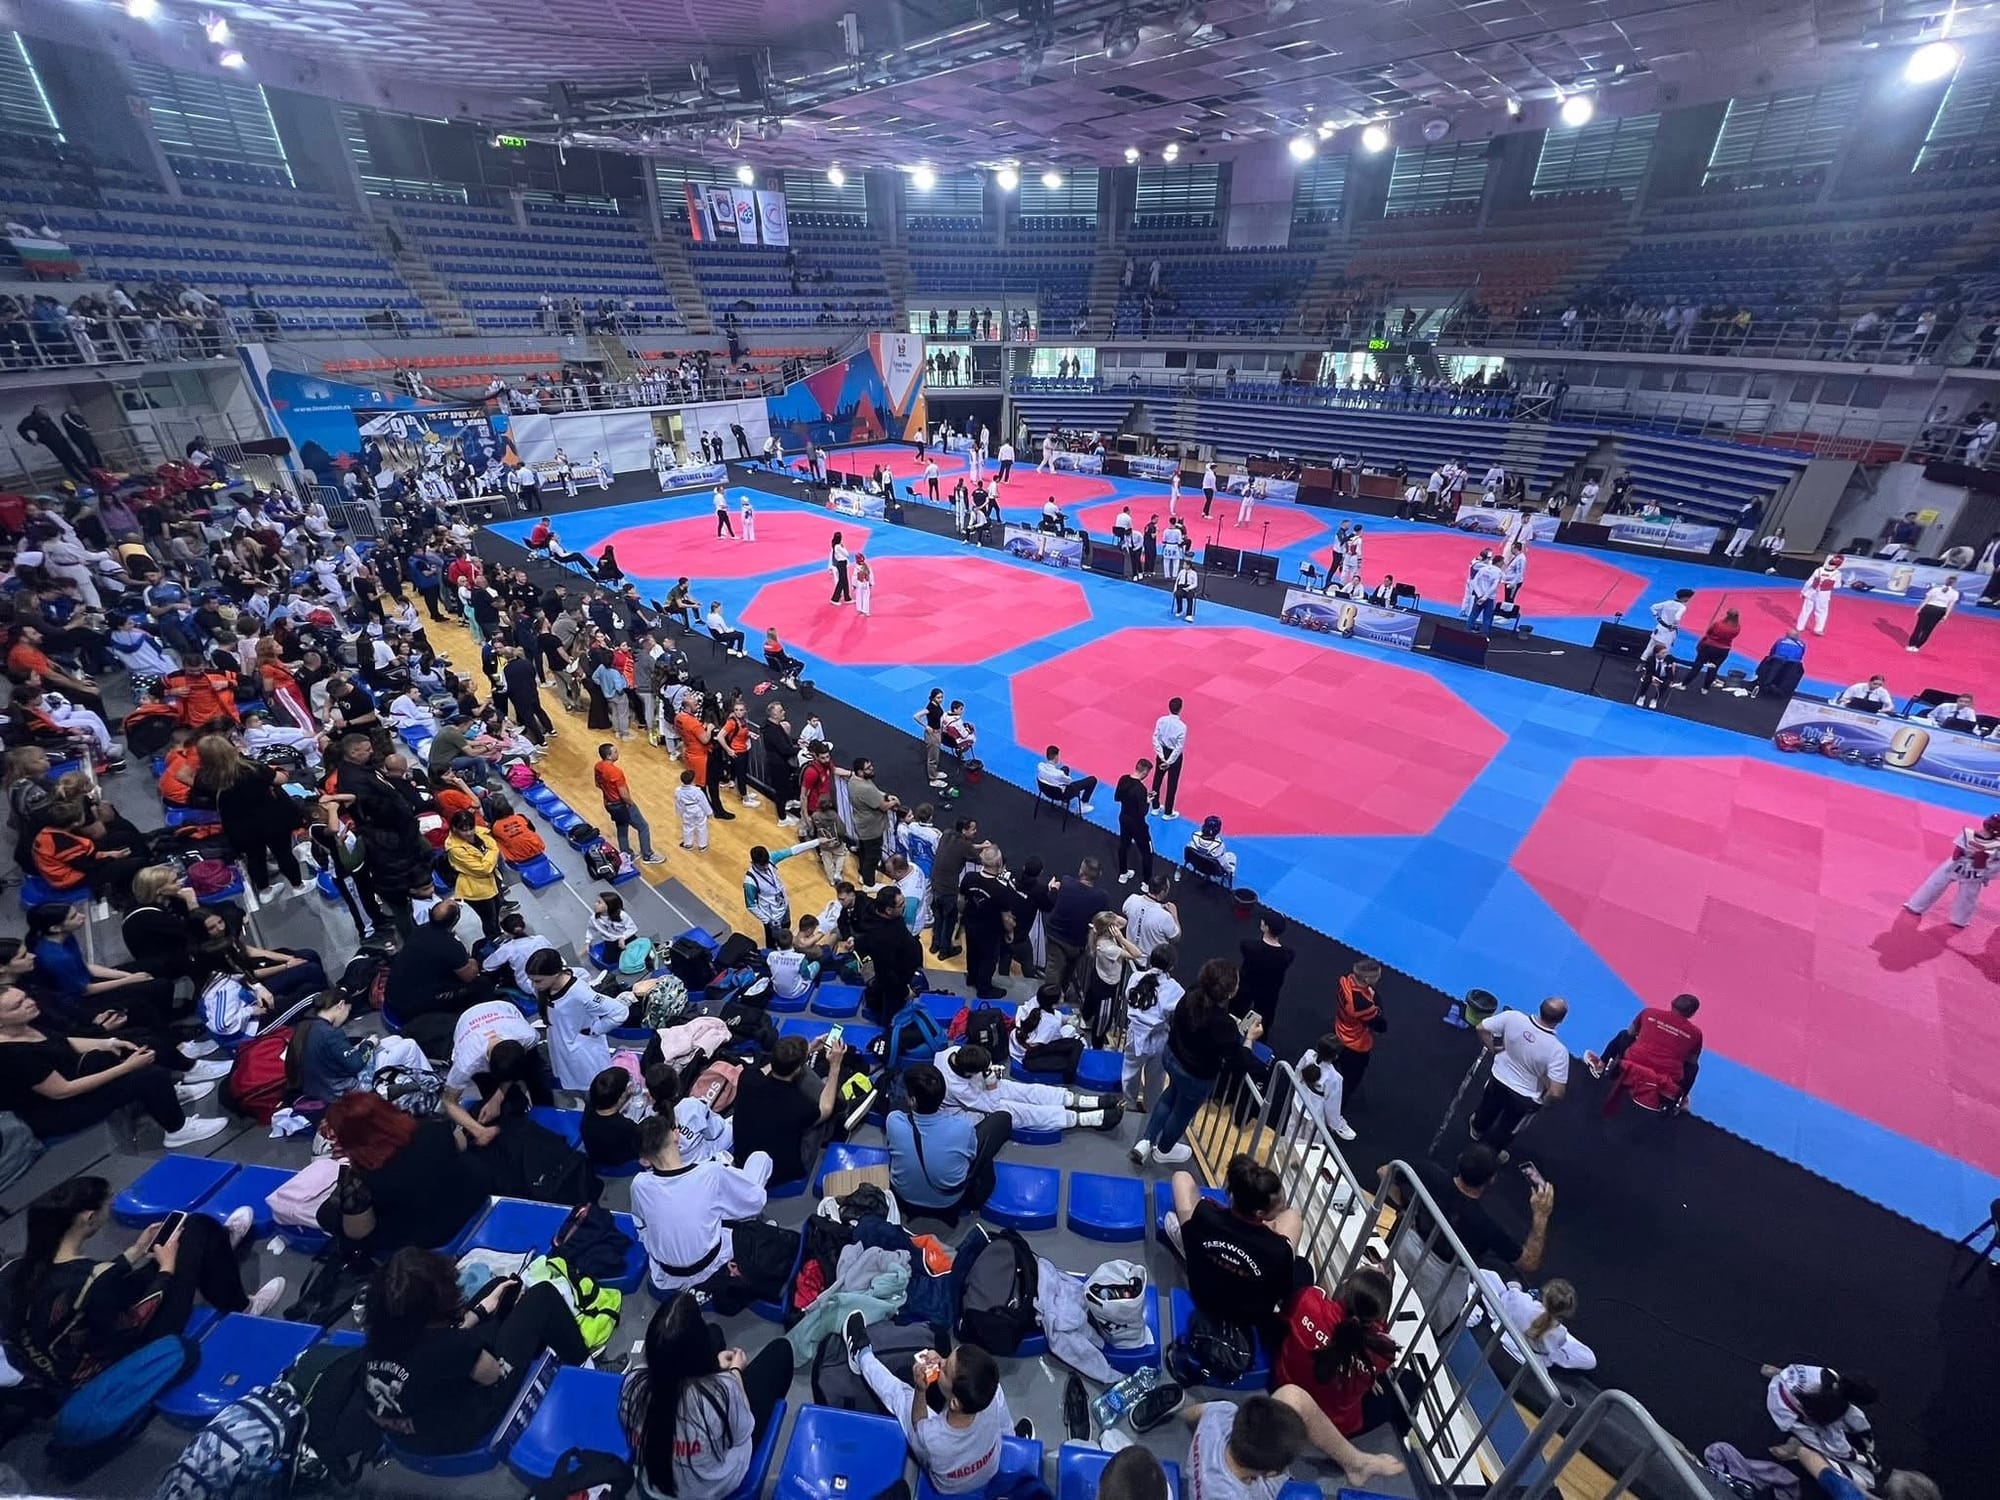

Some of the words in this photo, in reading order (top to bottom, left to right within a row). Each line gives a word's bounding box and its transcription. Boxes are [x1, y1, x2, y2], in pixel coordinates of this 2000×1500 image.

[1888, 566, 1915, 592] 5
[1337, 604, 1358, 632] 8
[1885, 726, 1931, 768] 9
[1203, 1241, 1261, 1276] TAEKWONDO
